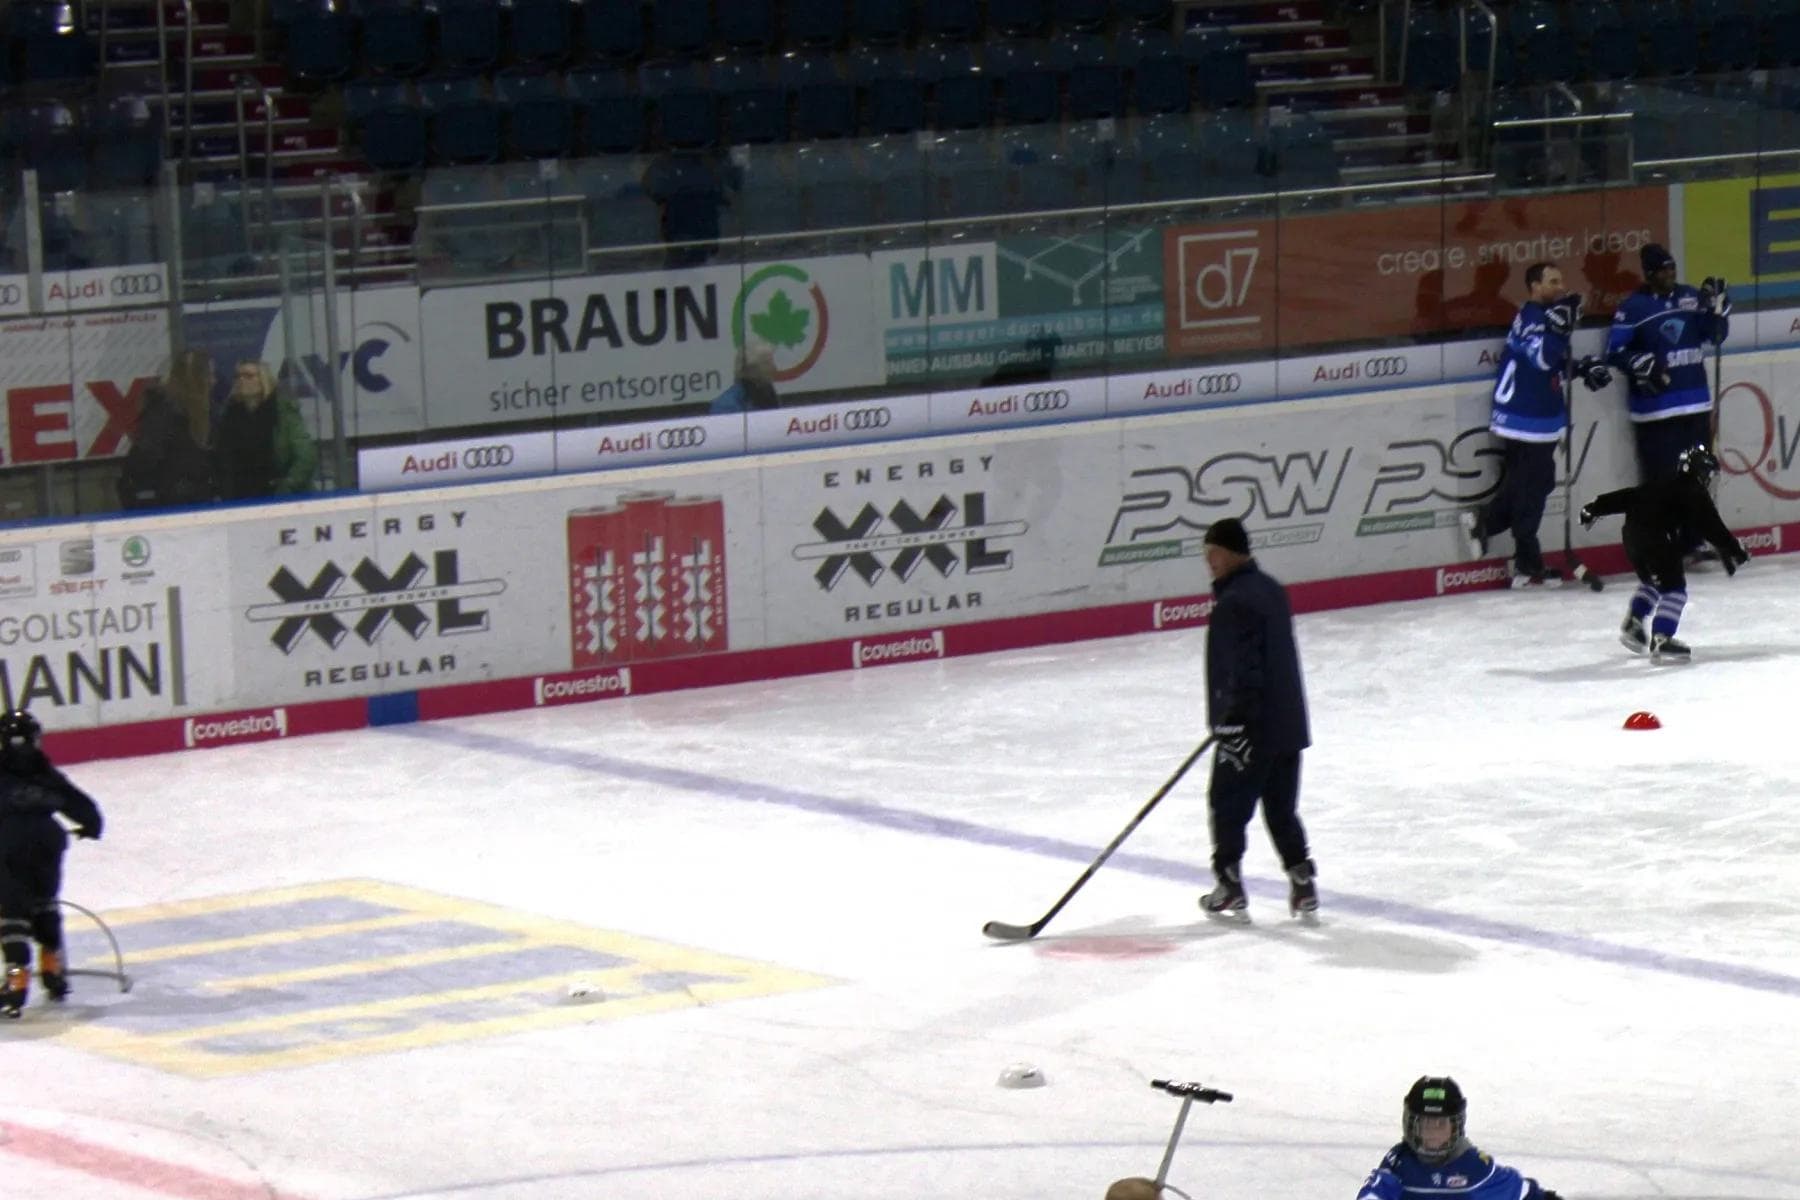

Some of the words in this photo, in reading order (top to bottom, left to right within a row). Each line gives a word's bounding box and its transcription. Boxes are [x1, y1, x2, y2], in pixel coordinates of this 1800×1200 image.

[48, 279, 104, 300] Audi
[890, 255, 985, 319] MM
[485, 283, 719, 360] BRAUN
[1114, 334, 1165, 354] MEYER
[1313, 361, 1361, 382] Audi
[490, 379, 570, 412] sicher
[581, 369, 723, 403] entsorgen
[1143, 379, 1193, 400] Audi
[0, 376, 162, 464] EX
[968, 395, 1019, 417] Audi
[786, 412, 839, 436] Audi
[598, 432, 652, 456] Audi
[402, 451, 458, 475] Audi
[823, 455, 994, 489] ENERGY
[279, 510, 467, 546] ENERGY
[812, 491, 1013, 594] XXL
[267, 549, 490, 656] XXL
[845, 591, 982, 623] REGULAR
[859, 634, 938, 663] covestro
[304, 654, 457, 688] REGULAR
[542, 674, 622, 700] covestro
[192, 714, 276, 740] covestro
